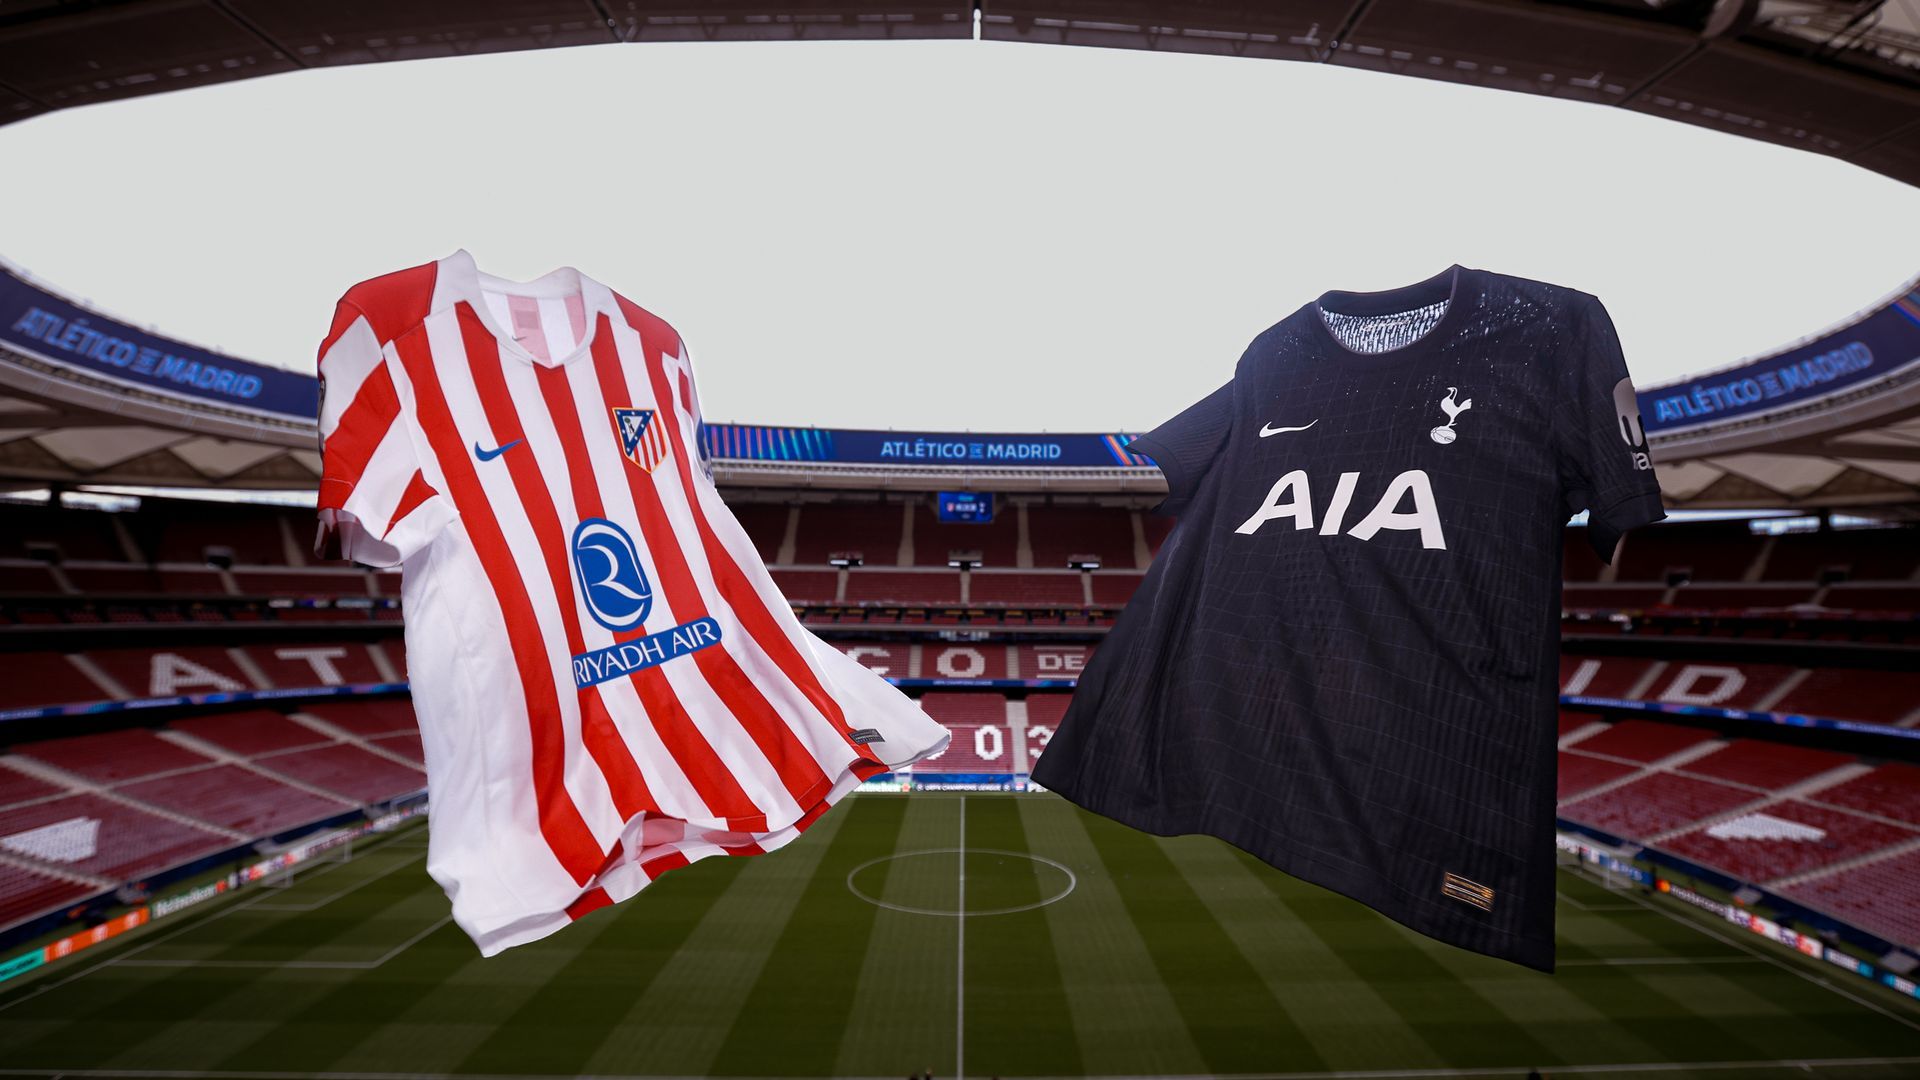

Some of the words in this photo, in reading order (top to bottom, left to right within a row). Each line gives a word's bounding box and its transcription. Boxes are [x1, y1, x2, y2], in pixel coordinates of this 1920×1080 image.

[11, 307, 138, 367] ATLÉTICO
[155, 354, 263, 398] MADRID
[1653, 379, 1762, 423] ATLÉTICO
[1778, 341, 1874, 390] MADRID
[880, 438, 966, 458] ATLÉTICO
[986, 443, 1062, 459] MADRID
[1234, 469, 1447, 550] AIA
[573, 637, 666, 686] RIYADH
[672, 621, 718, 655] AIR
